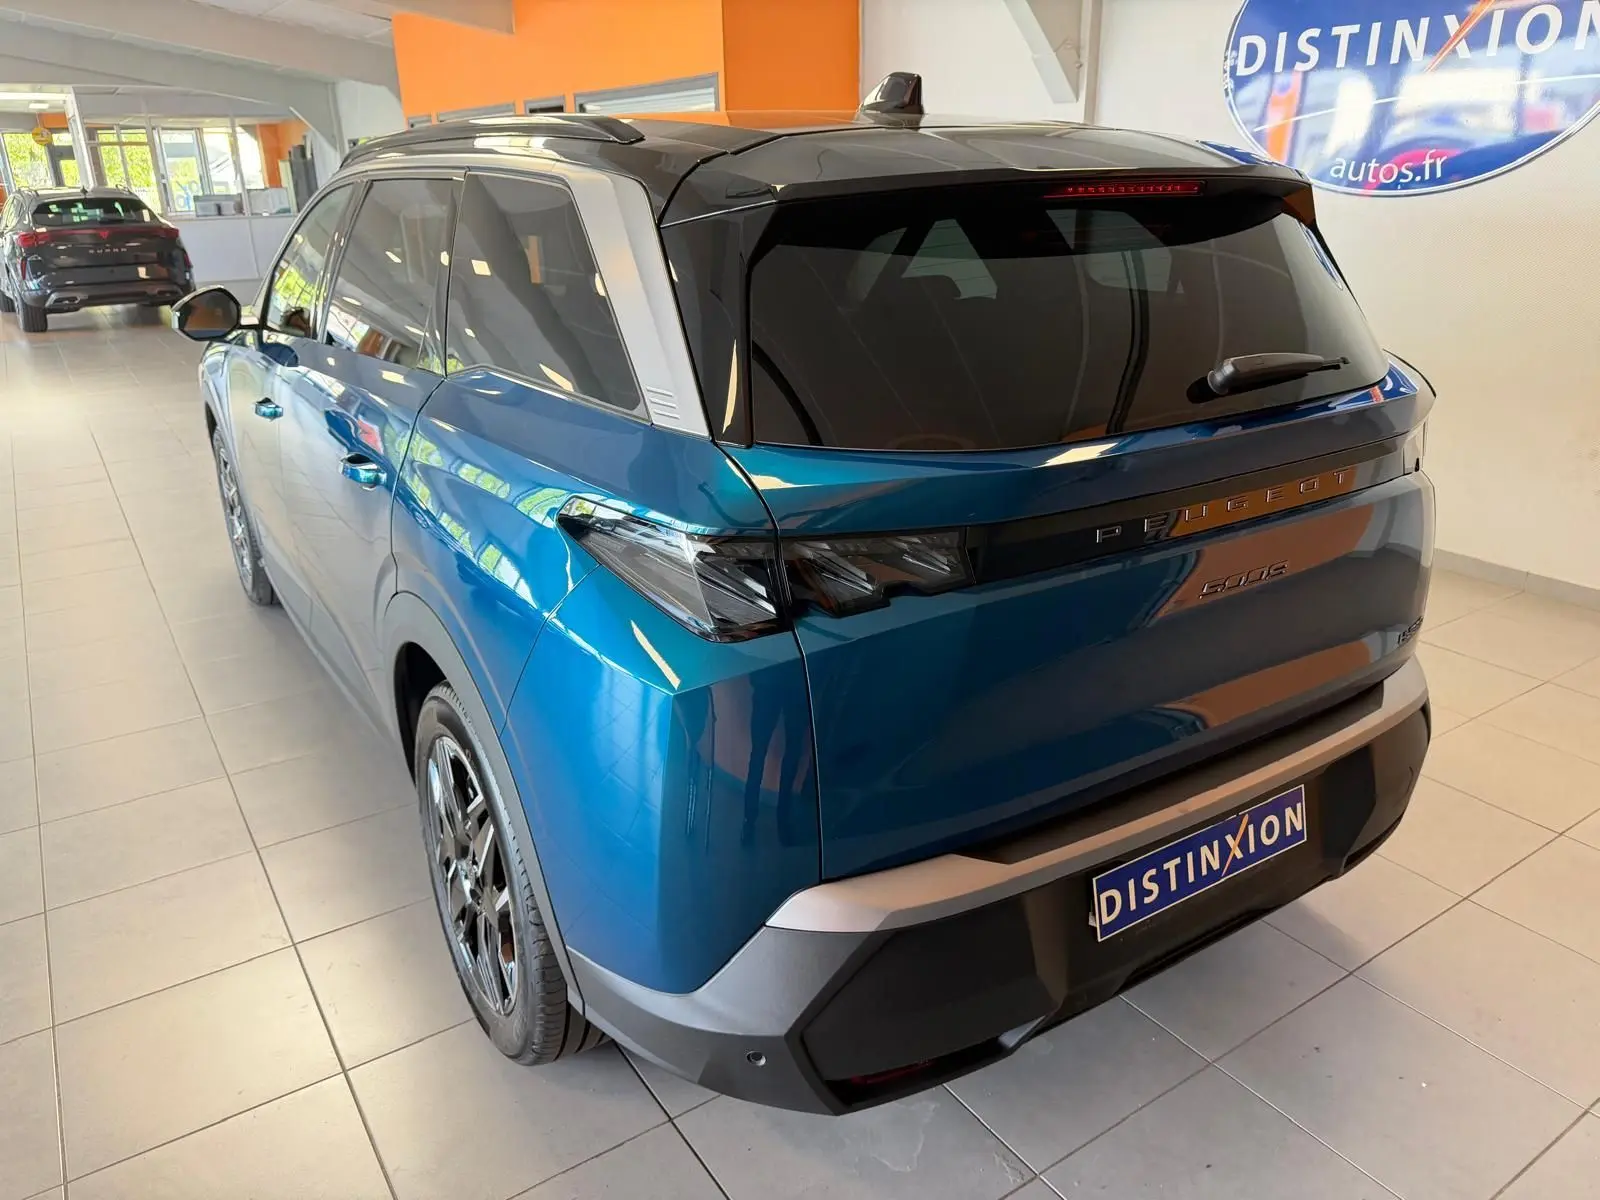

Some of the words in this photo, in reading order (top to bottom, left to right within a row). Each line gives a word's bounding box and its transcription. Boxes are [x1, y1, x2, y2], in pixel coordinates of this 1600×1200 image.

[1236, 0, 1600, 76] DISTINXION
[1329, 149, 1448, 184] autos.fr
[1096, 468, 1351, 543] PEUGEOT
[1099, 802, 1304, 926] DISTINXION
